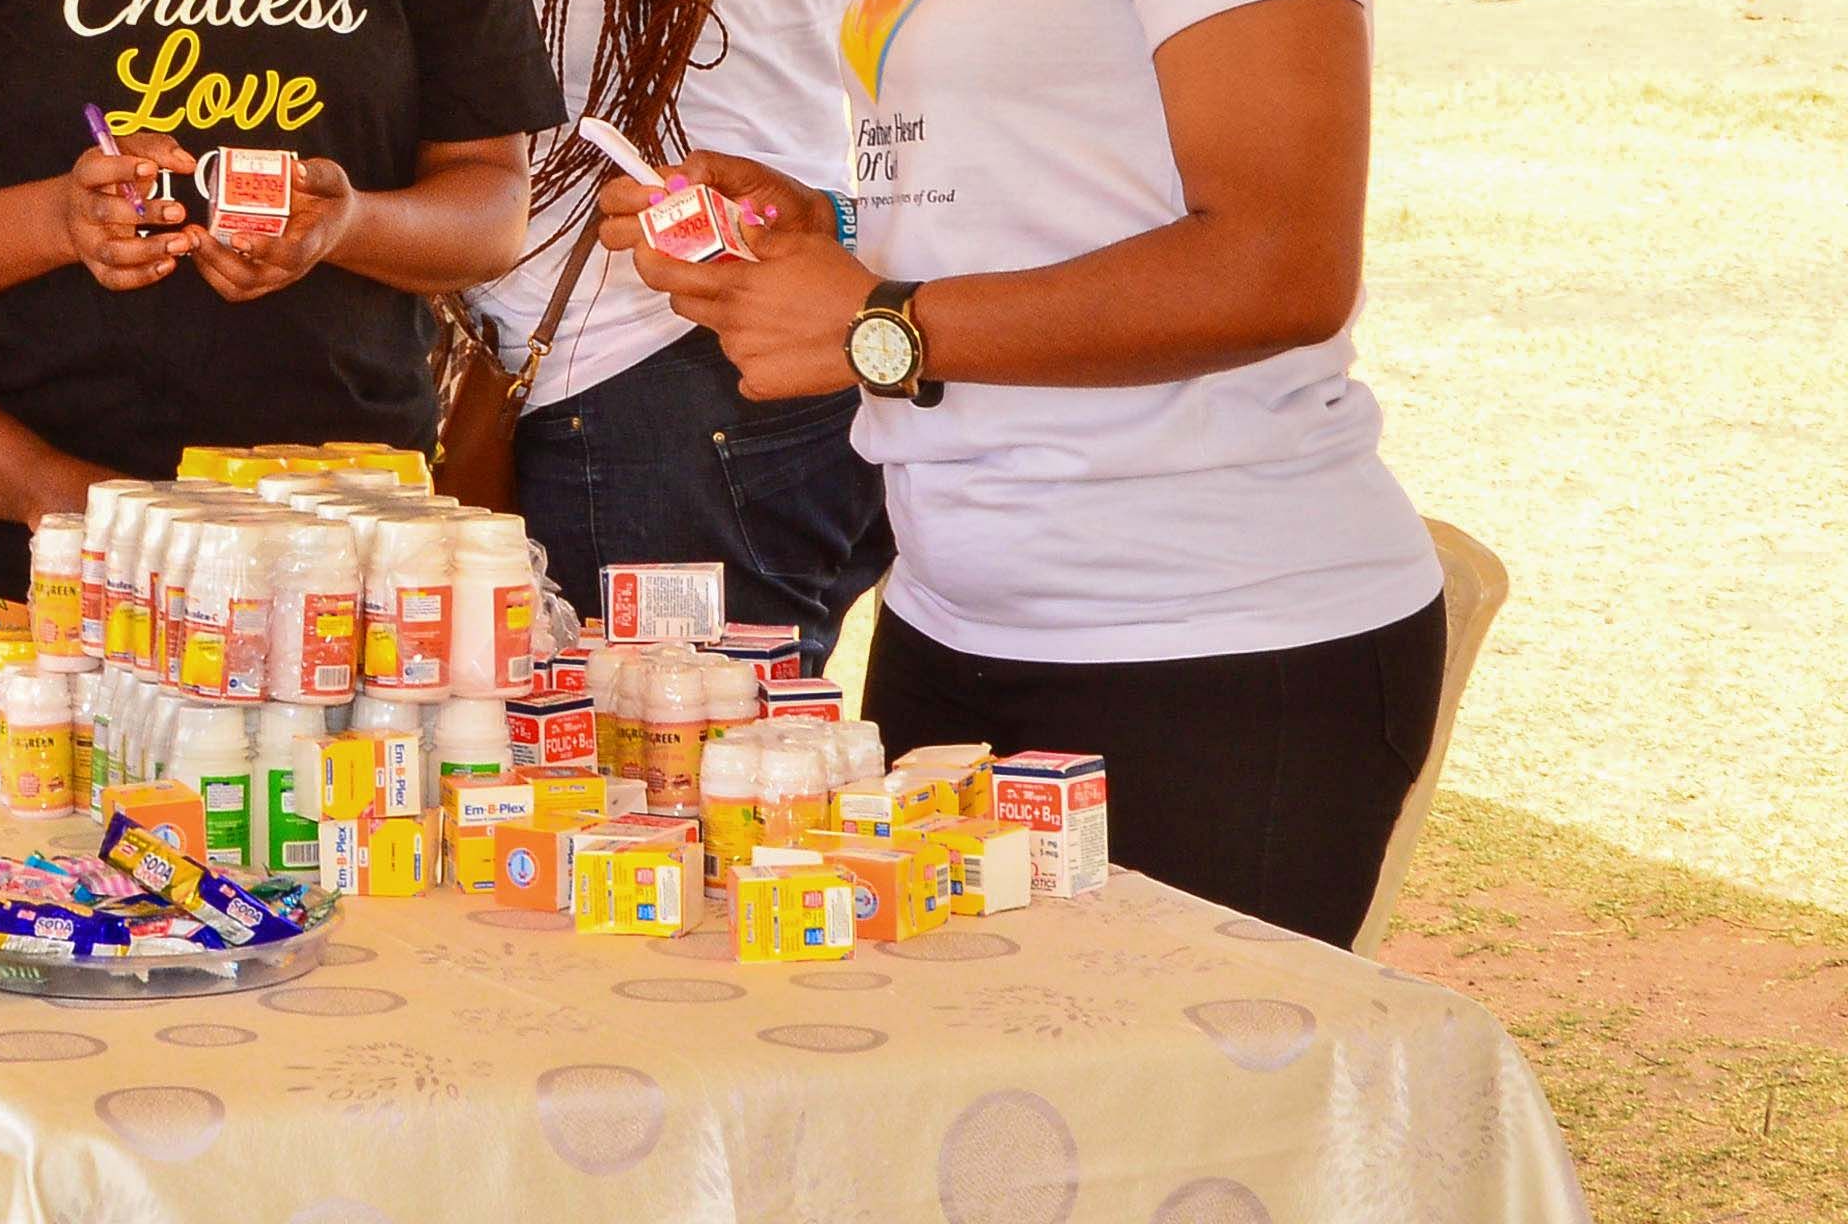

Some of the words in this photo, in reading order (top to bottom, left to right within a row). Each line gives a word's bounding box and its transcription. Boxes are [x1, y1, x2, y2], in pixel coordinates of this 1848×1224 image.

[104, 28, 324, 136] Love
[857, 151, 883, 182] Of
[927, 189, 956, 203] God
[464, 803, 526, 816] Em-B-Plex
[143, 853, 174, 880] SODA
[232, 898, 262, 923] SODA
[37, 917, 73, 933] SODA
